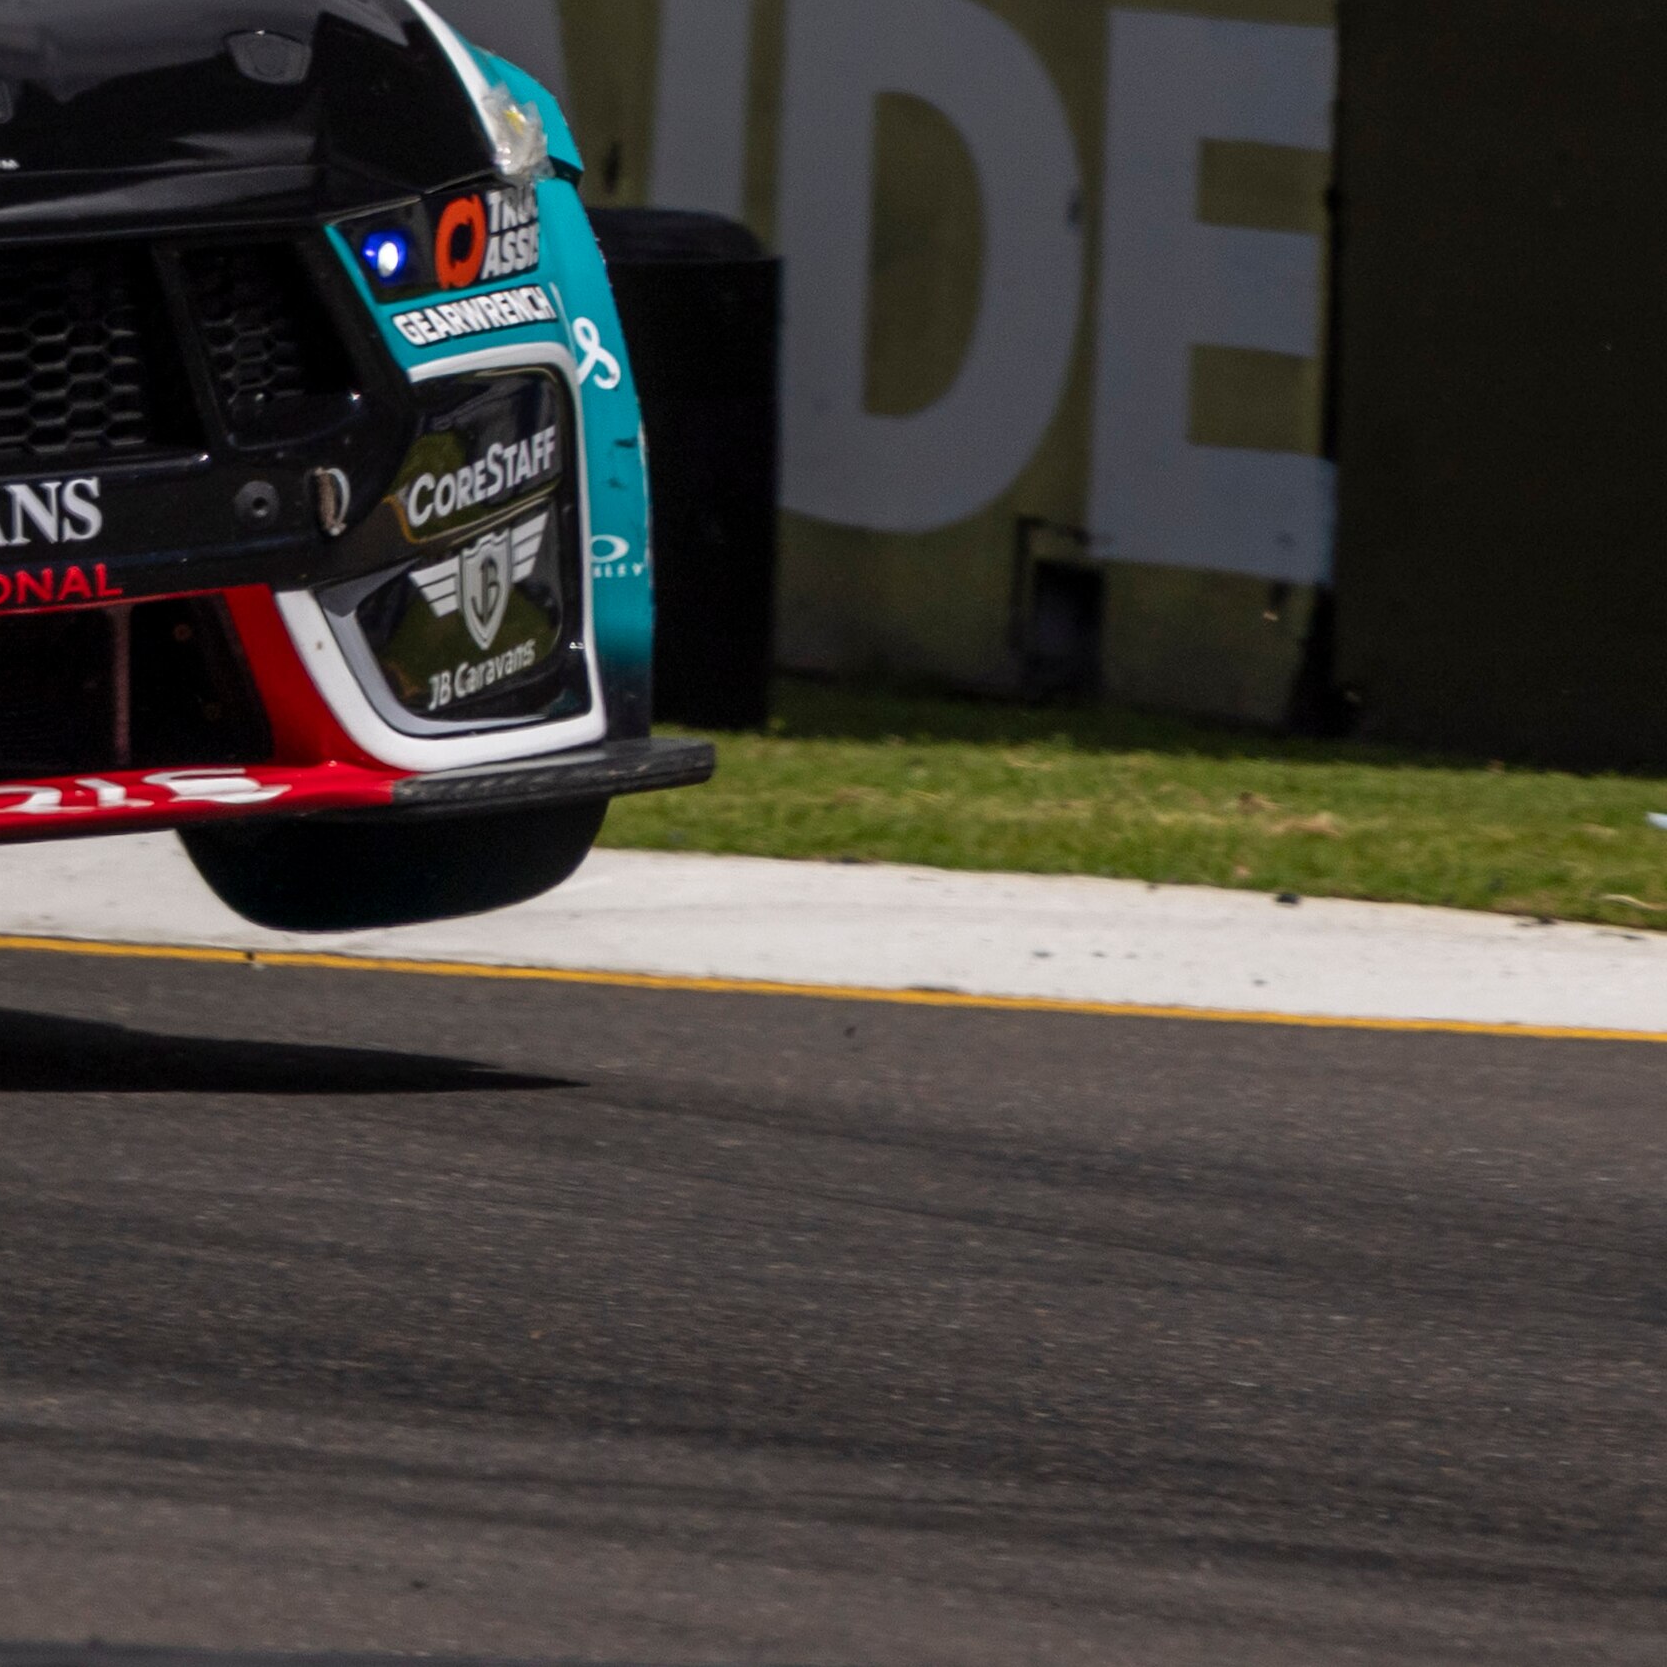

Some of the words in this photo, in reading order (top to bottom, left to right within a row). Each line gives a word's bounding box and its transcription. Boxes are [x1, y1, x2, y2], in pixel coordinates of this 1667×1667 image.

[392, 285, 558, 346] GEARWRENCH
[427, 669, 453, 712] JB
[453, 638, 537, 700] Caravans
